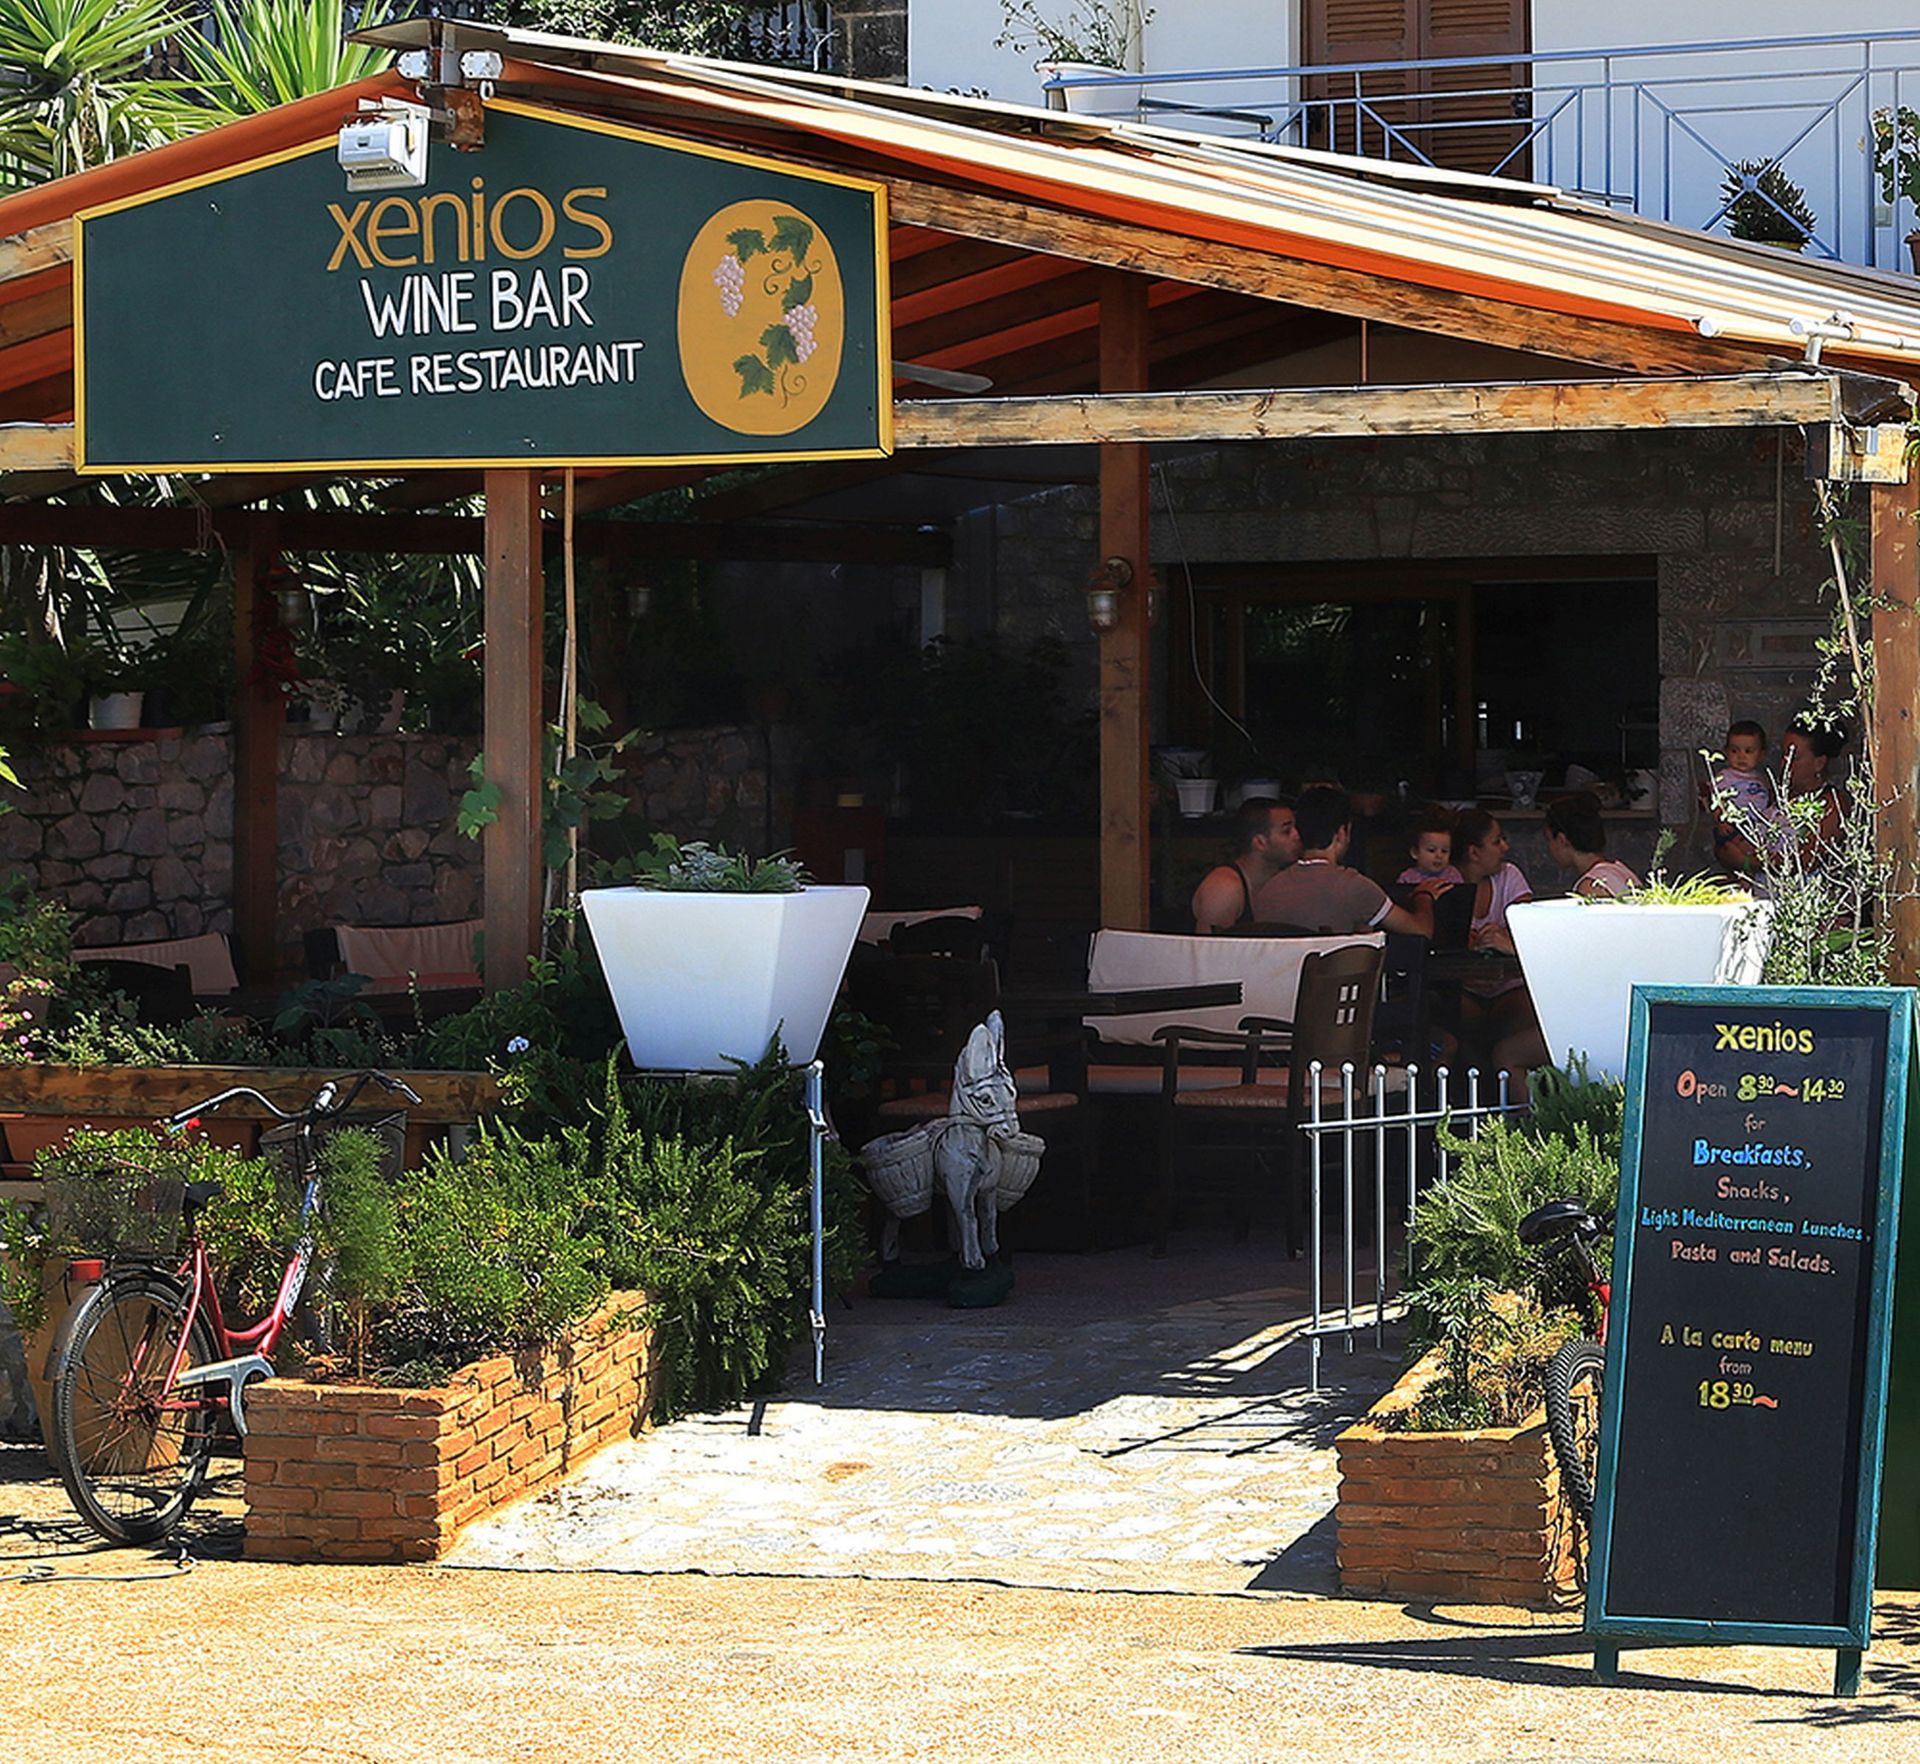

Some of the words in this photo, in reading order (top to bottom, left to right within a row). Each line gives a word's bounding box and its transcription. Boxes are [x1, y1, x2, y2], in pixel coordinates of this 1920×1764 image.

[326, 176, 613, 270] xenios
[360, 272, 477, 337] WINE
[491, 267, 593, 331] BAR
[314, 359, 401, 400] CAFE
[411, 342, 643, 394] RESTAURANT
[1677, 1070, 1727, 1103] Open
[1745, 1113, 1766, 1132] for
[1693, 1139, 1812, 1169] Breakfasts,
[1641, 1207, 1678, 1232] Light
[1682, 1208, 1794, 1234] Mediterranean
[1671, 1240, 1717, 1262] Pasta
[1730, 1247, 1761, 1265] and
[1767, 1248, 1837, 1275] Salads.
[1660, 1325, 1675, 1345] A
[1683, 1326, 1703, 1346] la
[1711, 1330, 1761, 1351] carte
[1770, 1338, 1813, 1356] menu
[1719, 1355, 1752, 1375] from
